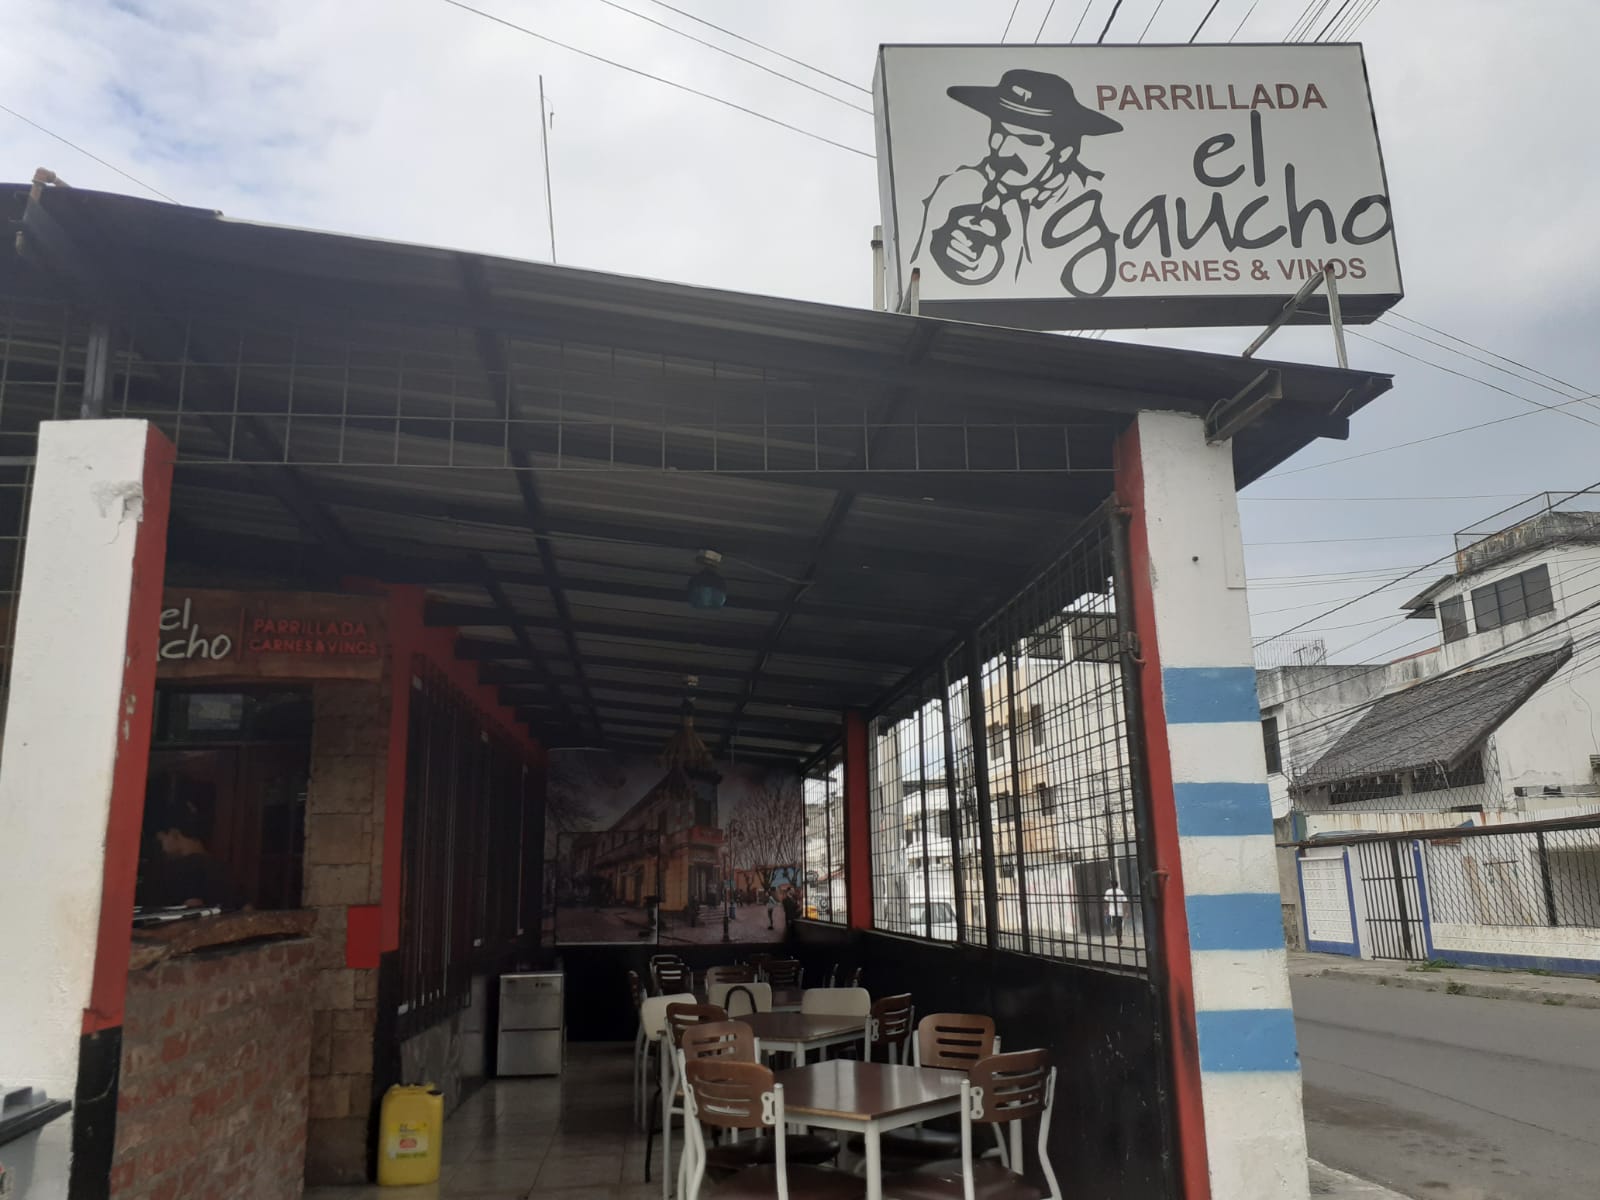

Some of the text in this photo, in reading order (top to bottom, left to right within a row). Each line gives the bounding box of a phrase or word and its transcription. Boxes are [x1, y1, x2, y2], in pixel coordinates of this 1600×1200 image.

[1095, 83, 1328, 111] PARRILLADA
[1193, 110, 1266, 187] el
[1041, 162, 1391, 298] gaucho
[1118, 257, 1367, 283] CARNES & VINOS
[159, 597, 191, 631] el
[253, 618, 368, 637] PARRILLADA
[156, 624, 232, 662] cho
